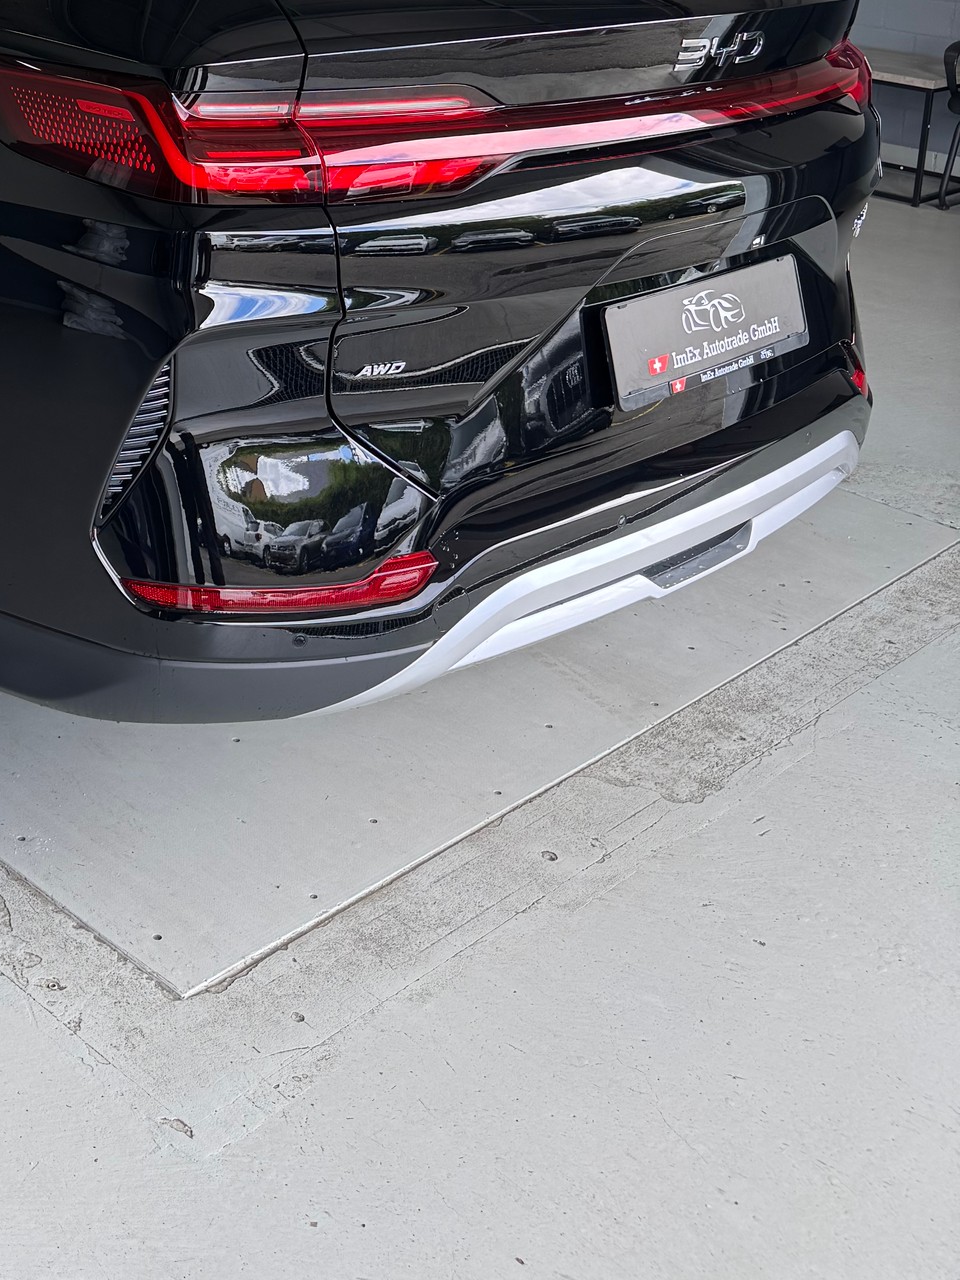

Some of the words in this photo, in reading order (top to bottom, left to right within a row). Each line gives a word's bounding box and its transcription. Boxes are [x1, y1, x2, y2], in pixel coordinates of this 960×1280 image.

[673, 31, 765, 72] BYD
[671, 346, 702, 369] ImEx
[702, 329, 749, 359] Autotrade
[750, 316, 781, 341] GmbH
[355, 361, 407, 378] AWD
[715, 362, 739, 378] Autotrade
[738, 354, 755, 369] GmbH
